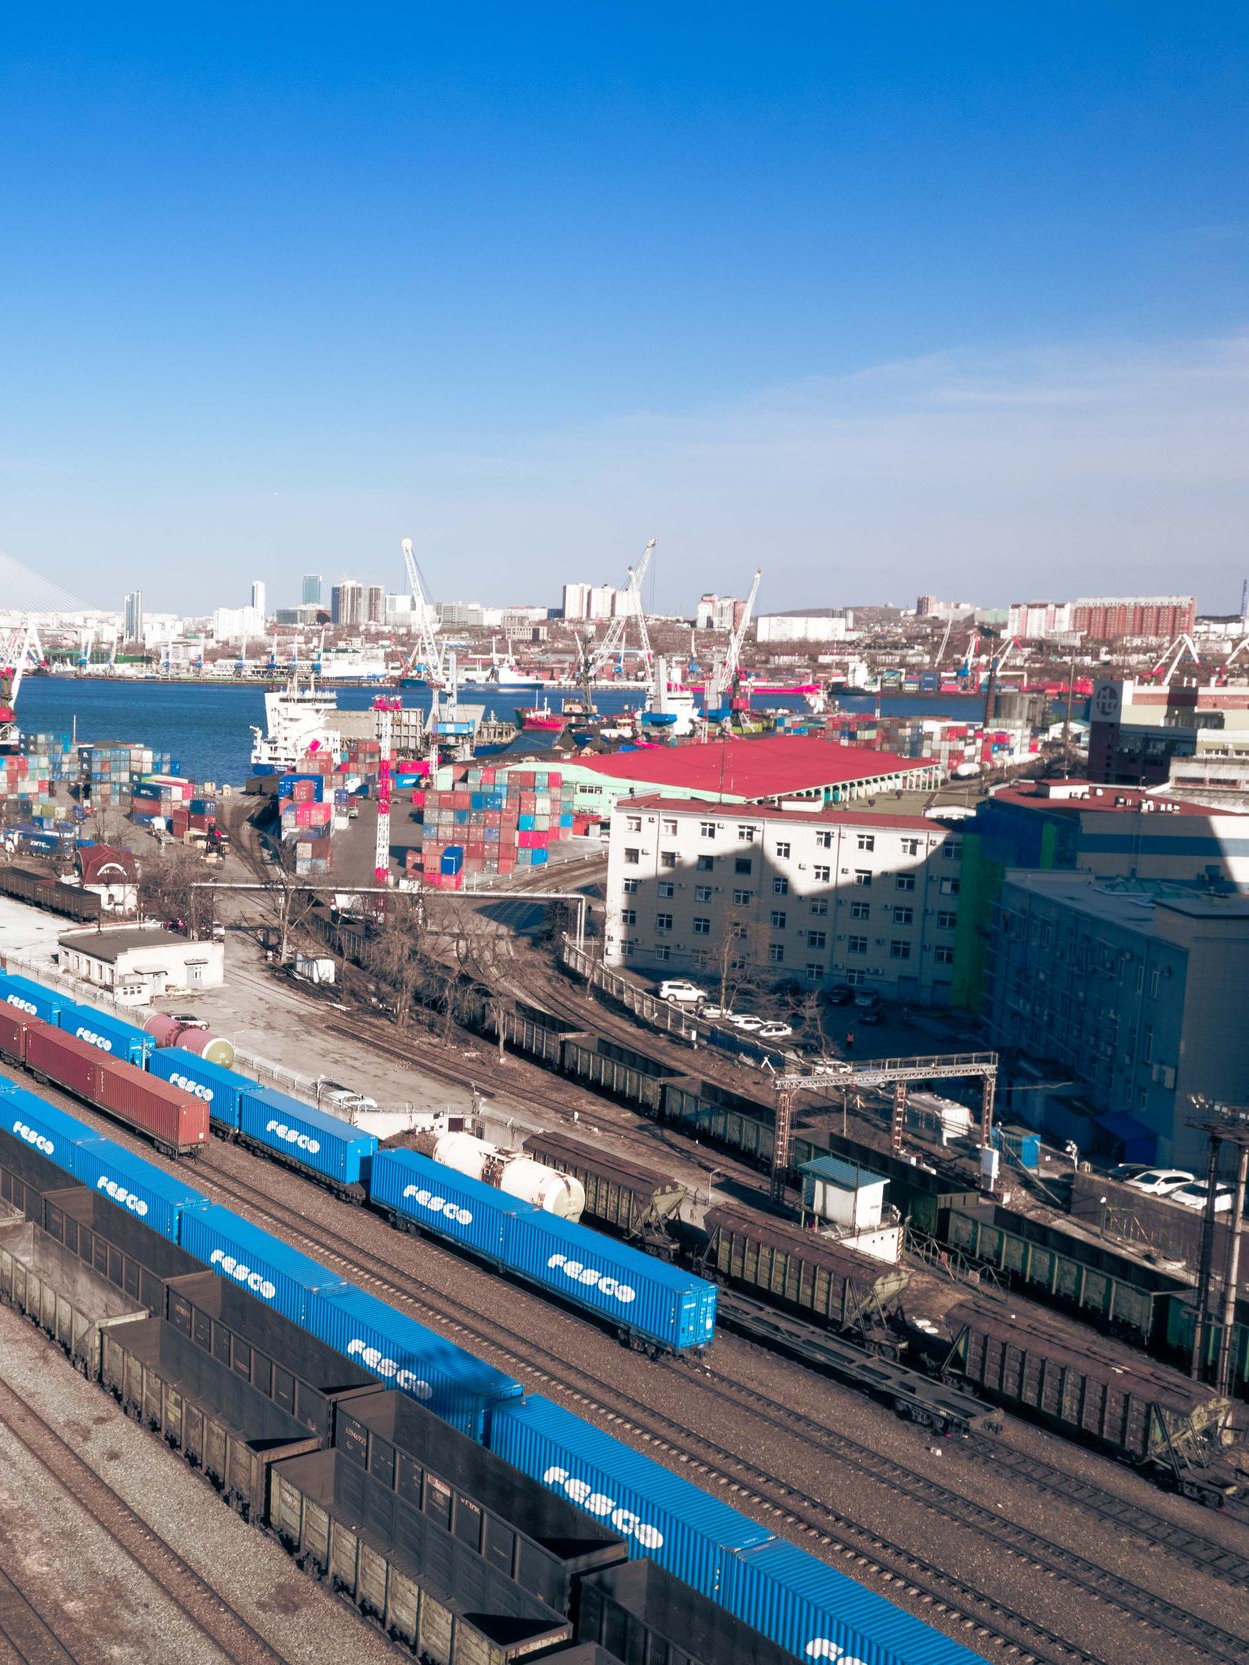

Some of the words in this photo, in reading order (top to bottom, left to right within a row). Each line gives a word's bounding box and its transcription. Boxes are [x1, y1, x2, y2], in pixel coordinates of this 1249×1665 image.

[7, 995, 37, 1016] FESCO
[76, 1028, 111, 1051] FESCO
[170, 1073, 213, 1104] FESCO
[14, 1122, 54, 1154] FESCO
[267, 1120, 320, 1153] FESCO
[98, 1176, 147, 1216] FESCO
[404, 1185, 472, 1225] FESCO
[211, 1250, 275, 1298] FESCO
[548, 1254, 635, 1302] FESCO
[348, 1339, 433, 1400] FESCO
[544, 1467, 663, 1549] FESCO
